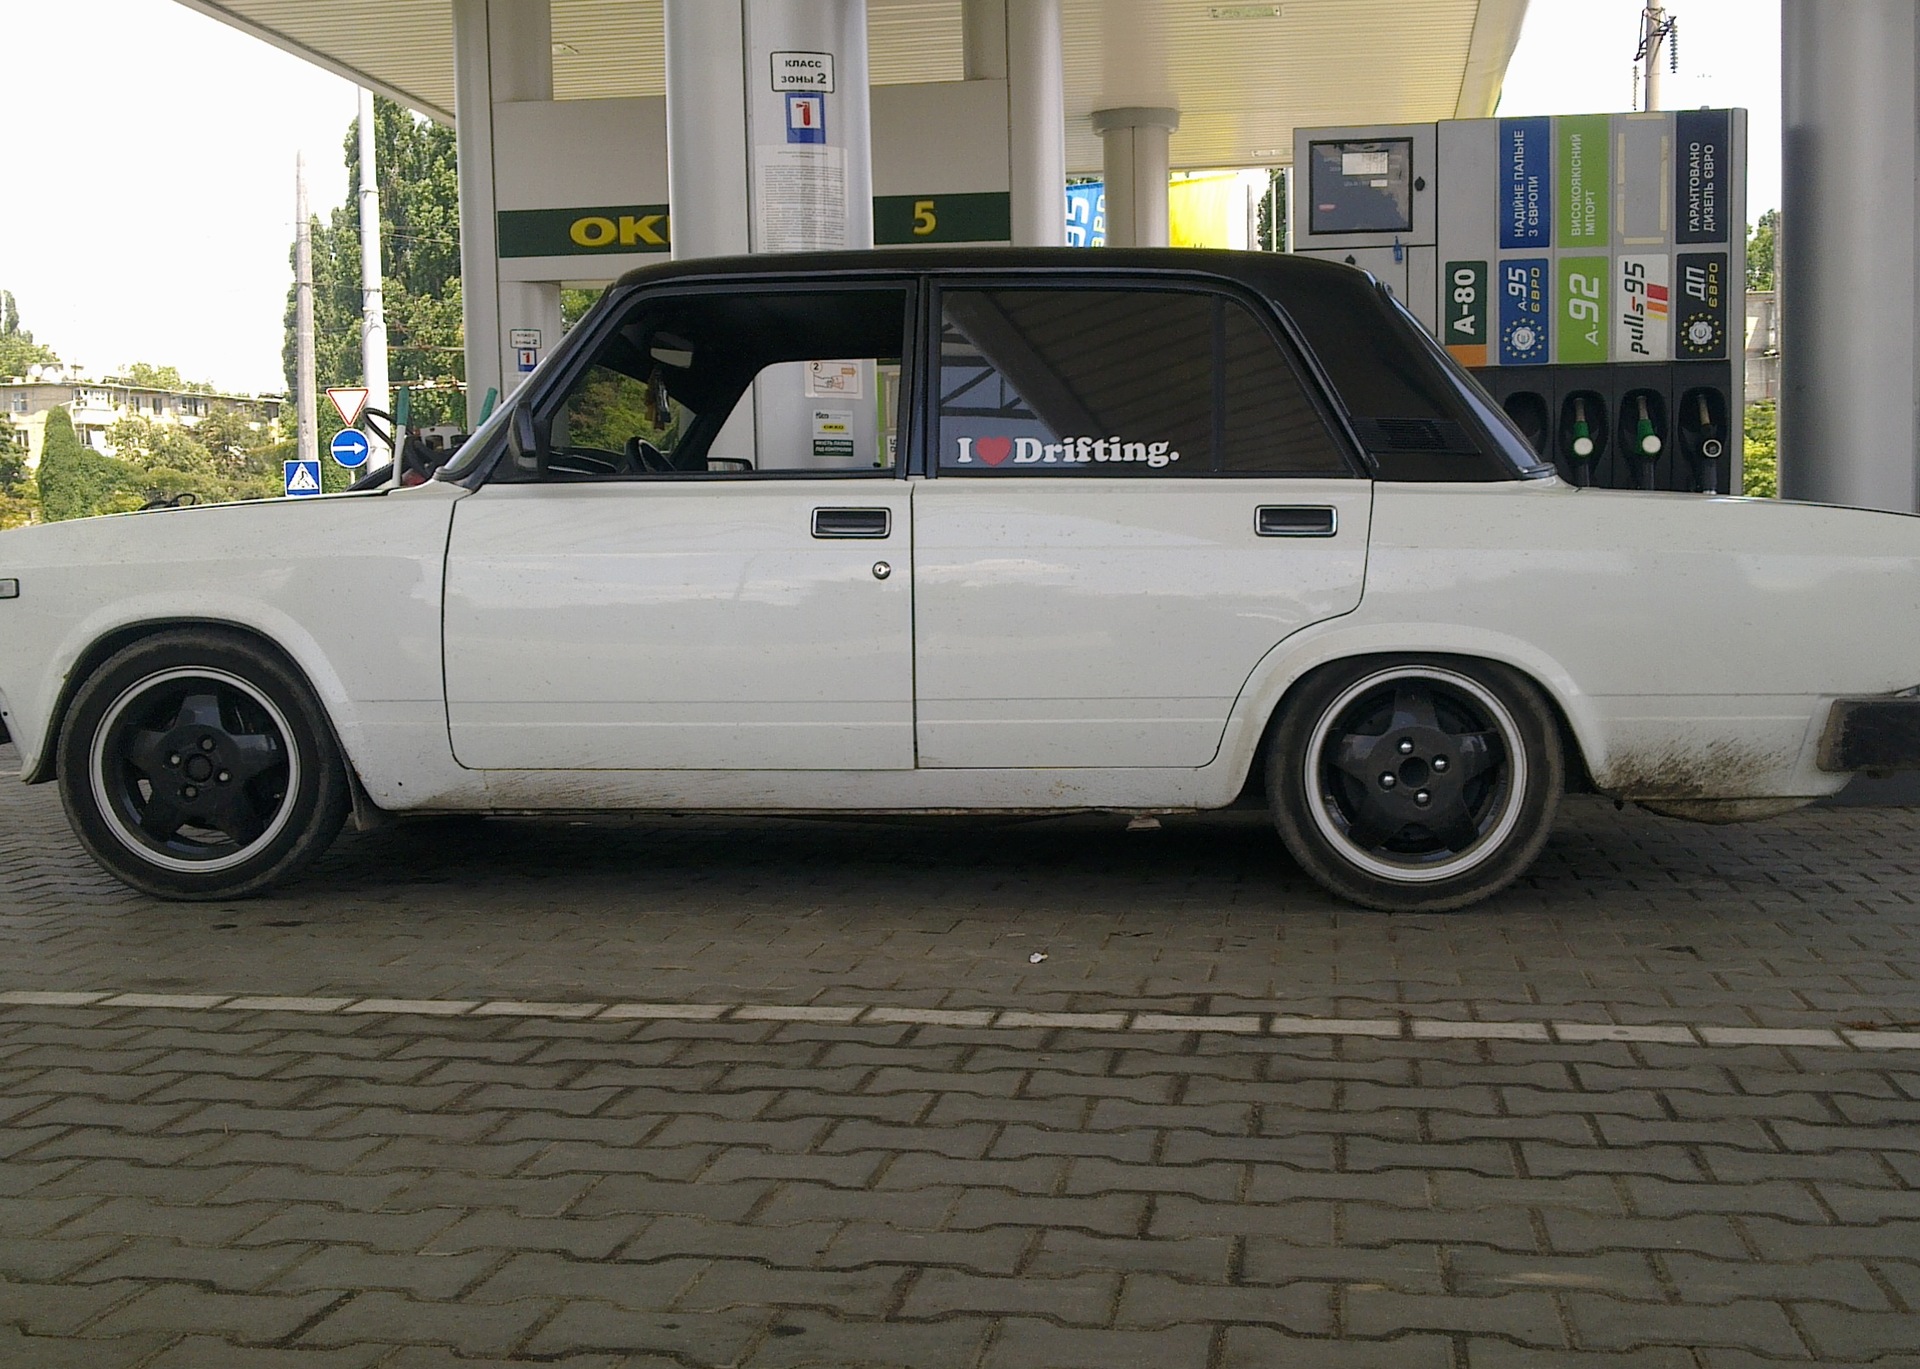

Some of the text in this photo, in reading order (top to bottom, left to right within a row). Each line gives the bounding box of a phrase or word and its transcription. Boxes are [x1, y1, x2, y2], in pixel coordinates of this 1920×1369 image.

[781, 73, 827, 84] ЗОНЫ 2
[785, 60, 822, 68] КЛАСС
[1513, 130, 1526, 237] НАДІЙНЕ ПАЛЬНЕ
[1528, 176, 1538, 225] ЄВРОПИ
[1570, 133, 1581, 236] ВИСОКОЯКІСНИЙ
[1689, 142, 1700, 232] ГАРАНТОВАНО
[1703, 144, 1716, 232] ДИЗЕЛЬ ЄВРО
[570, 215, 670, 247] OK
[913, 200, 937, 235] 5
[1585, 190, 1595, 236] ІМПОРТ
[1454, 268, 1475, 335] А-80
[1686, 266, 1706, 301] ДП
[813, 362, 820, 371] 2
[957, 436, 1180, 467] I Drifting.
